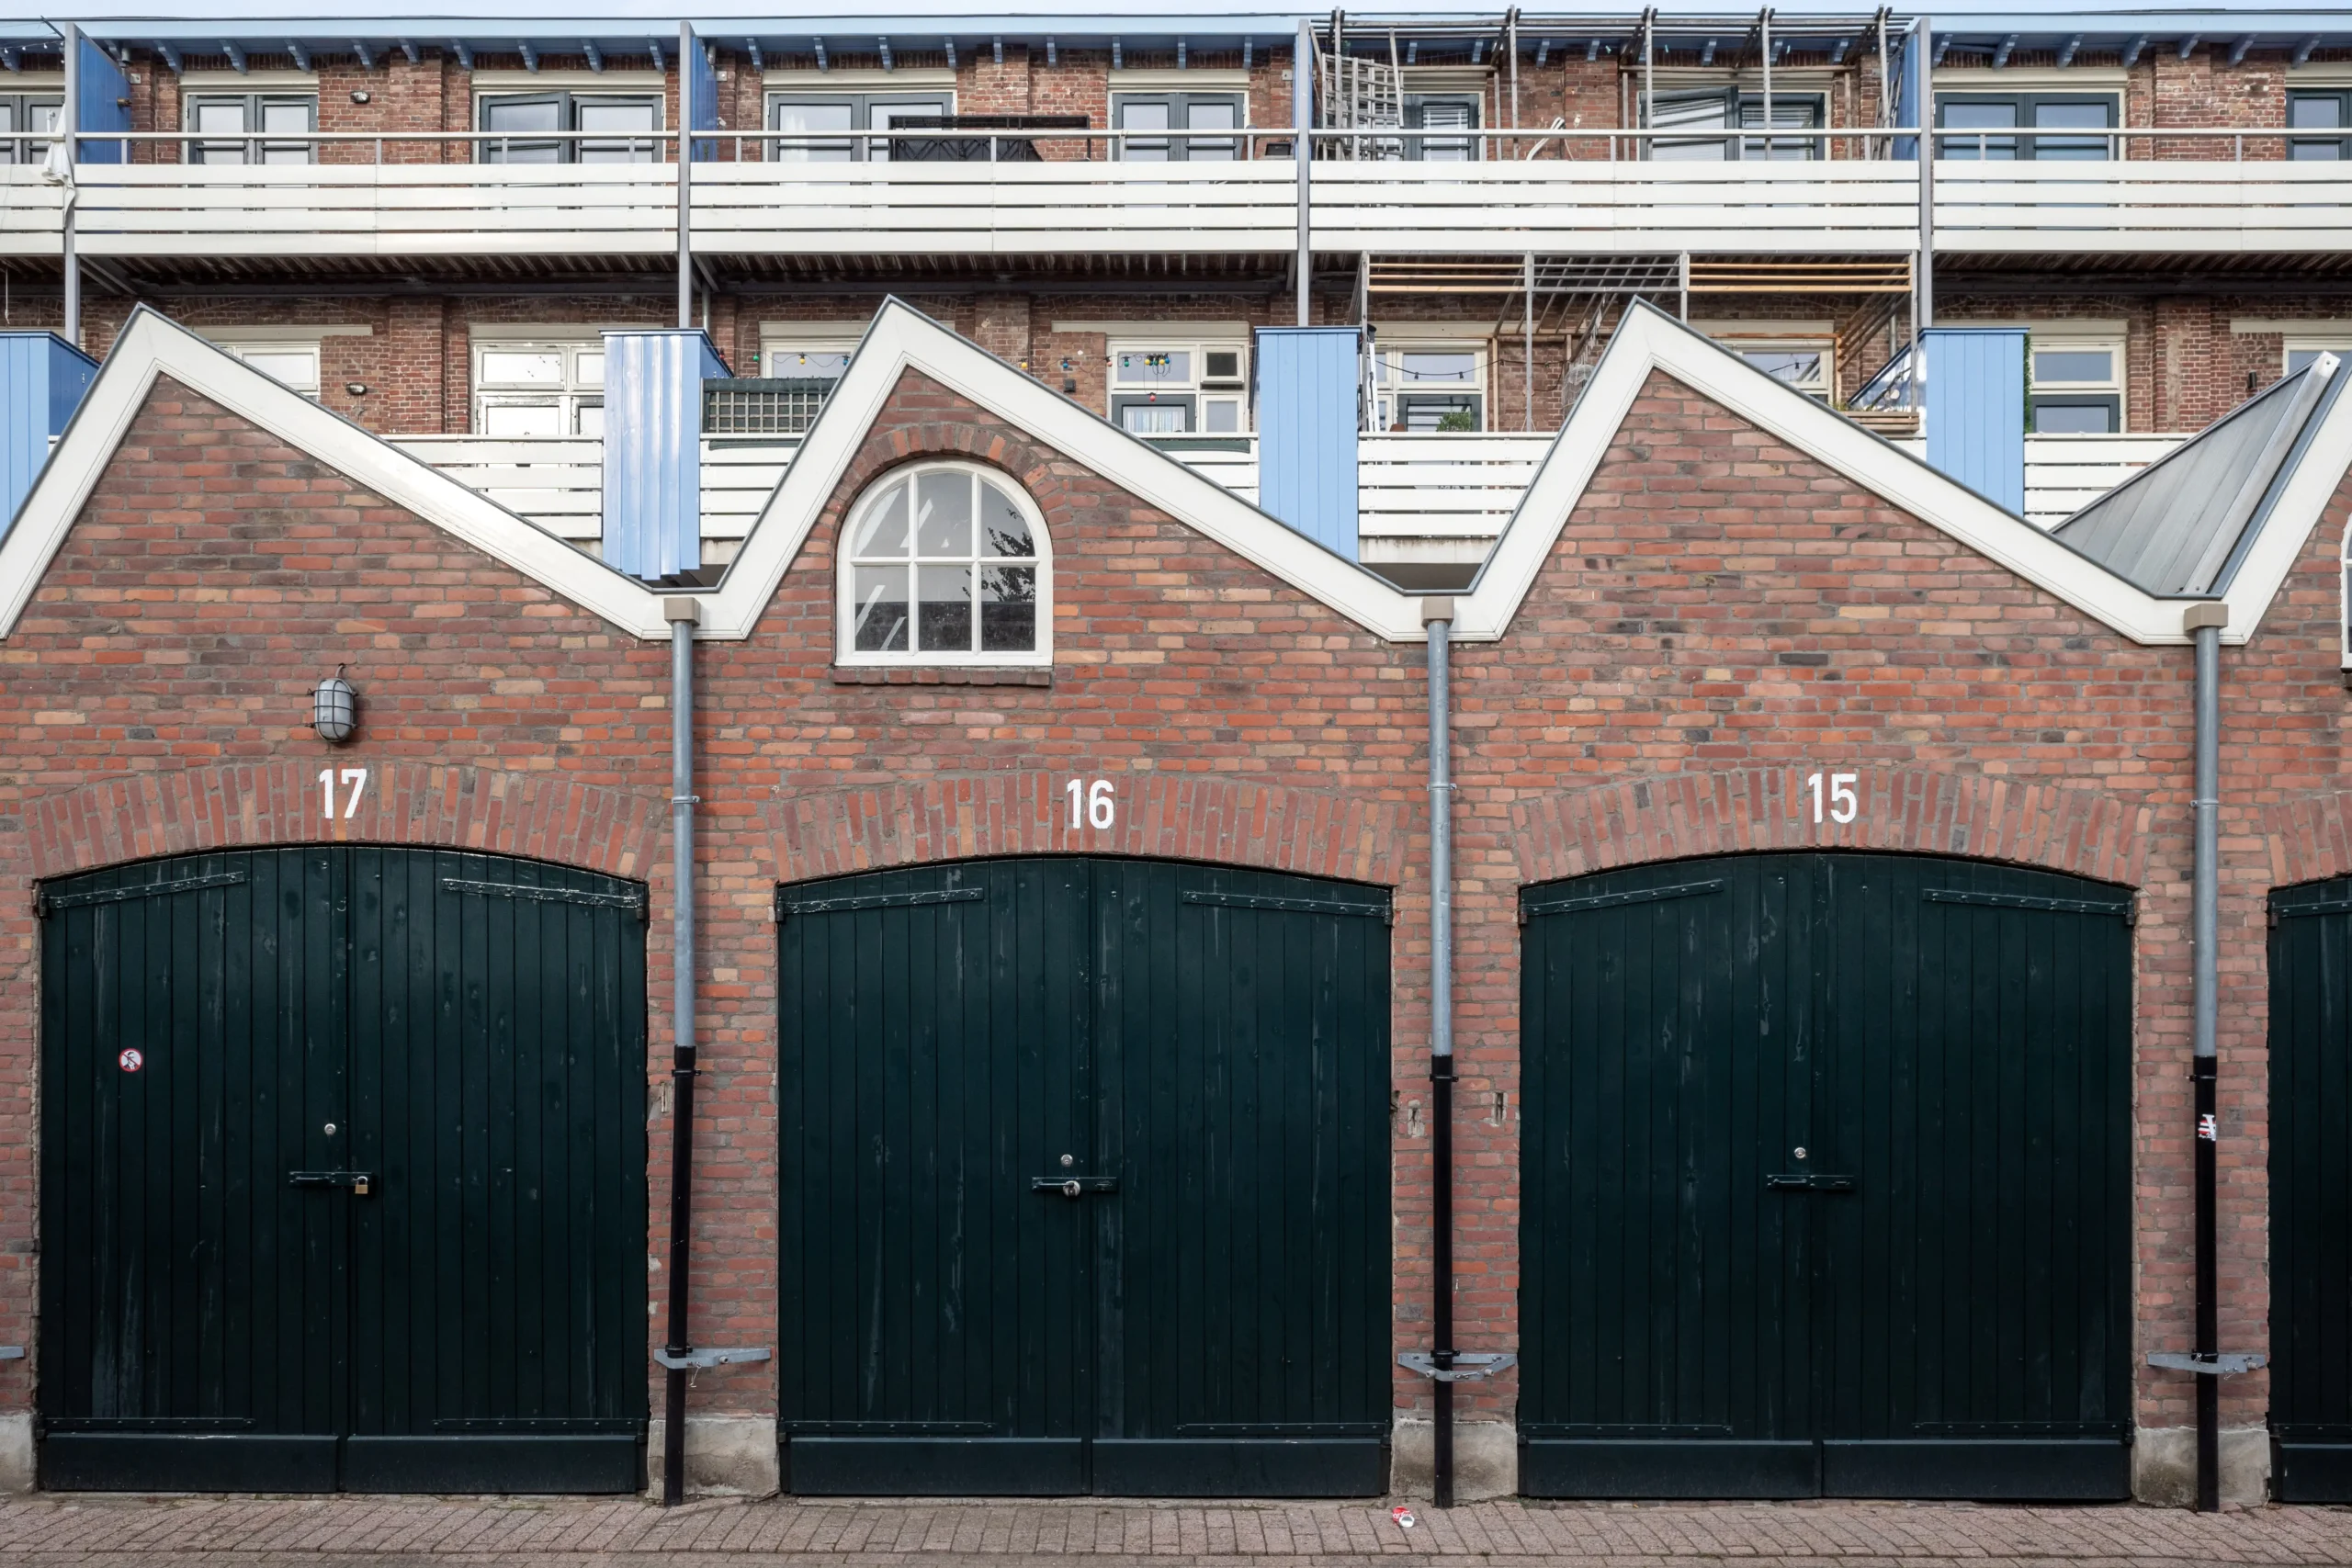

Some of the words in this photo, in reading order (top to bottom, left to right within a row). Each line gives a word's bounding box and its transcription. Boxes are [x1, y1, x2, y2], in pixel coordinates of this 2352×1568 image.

[319, 768, 368, 819] 17
[1066, 778, 1114, 829] 16
[1807, 773, 1858, 824] 15
